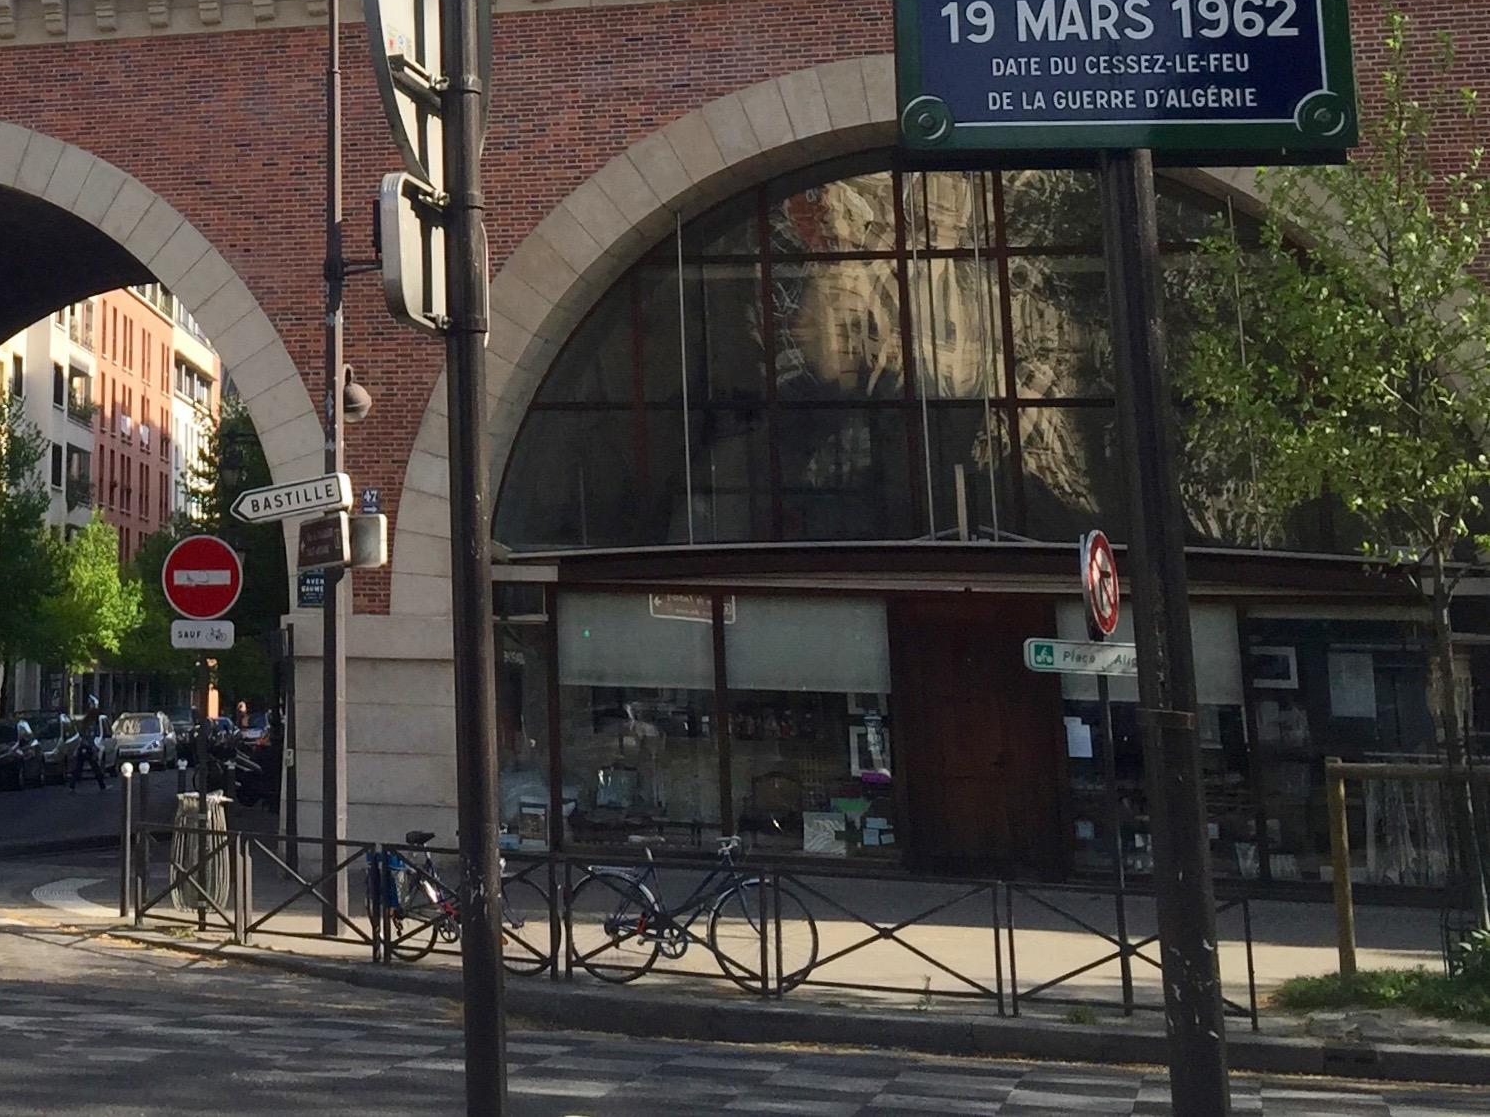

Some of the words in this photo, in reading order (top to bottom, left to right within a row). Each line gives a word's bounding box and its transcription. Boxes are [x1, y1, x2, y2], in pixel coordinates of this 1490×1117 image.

[940, 0, 995, 44] 19
[992, 57, 1041, 77] DATE
[1050, 55, 1077, 75] DU
[1085, 53, 1250, 75] CESSEZ-LE-FEU
[988, 91, 1014, 110] DE
[1021, 90, 1045, 110] LA
[1053, 89, 1135, 109] GUERRE
[1145, 85, 1258, 108] D'ALGÉRIE
[251, 484, 334, 513] BASTILLE
[363, 489, 378, 502] 47
[178, 630, 201, 639] SAUF
